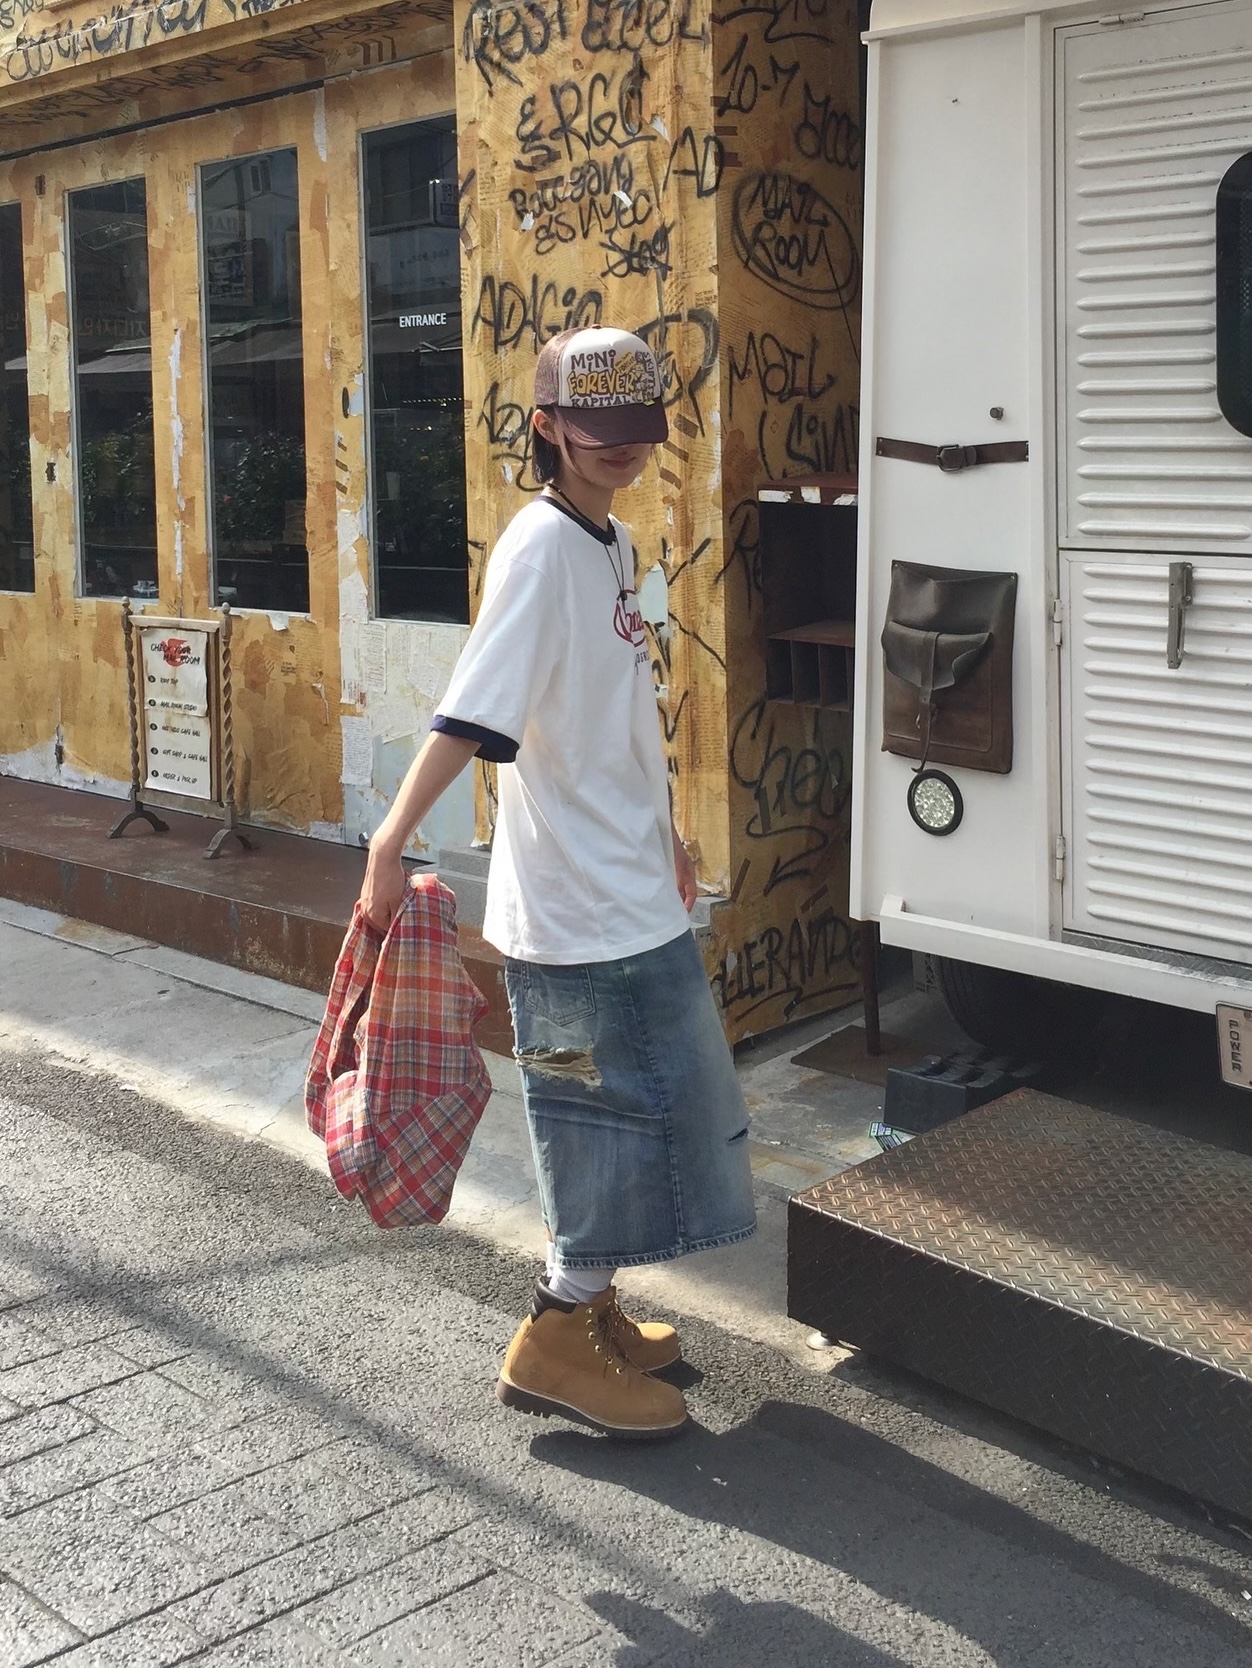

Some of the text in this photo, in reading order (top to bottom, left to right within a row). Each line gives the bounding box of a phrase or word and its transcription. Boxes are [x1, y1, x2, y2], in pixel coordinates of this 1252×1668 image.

[399, 312, 447, 328] ENTRANCE
[567, 370, 636, 397] FOREVER
[571, 396, 630, 408] KAPITAL
[1228, 1019, 1242, 1073] POWER
